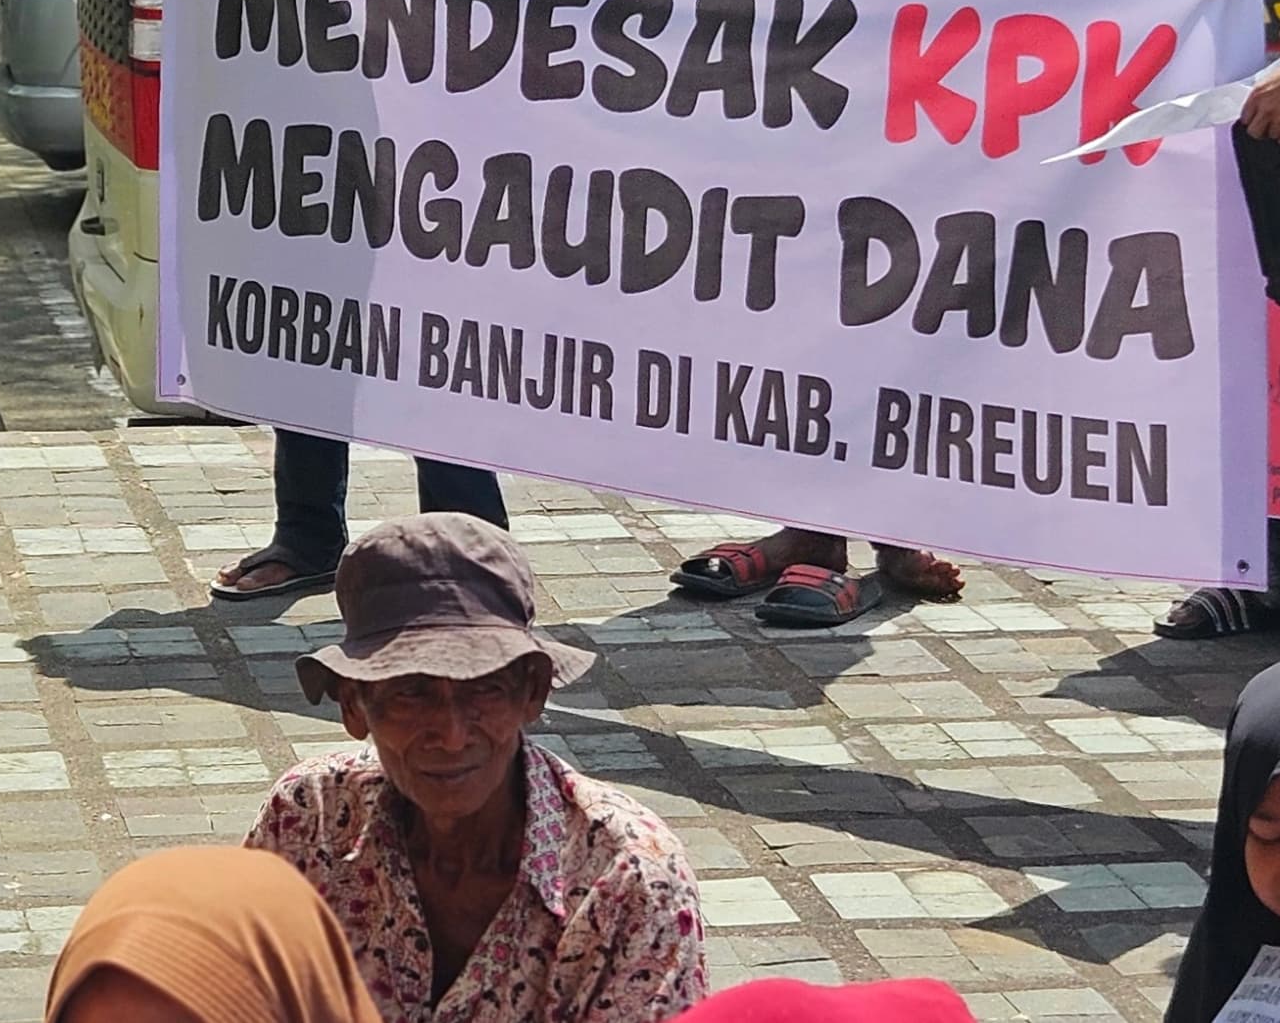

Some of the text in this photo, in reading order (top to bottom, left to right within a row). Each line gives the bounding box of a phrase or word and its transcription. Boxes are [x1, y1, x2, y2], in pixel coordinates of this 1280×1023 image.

[885, 4, 1177, 166] KPK
[197, 114, 1194, 360] MENGAUDIT DANA
[208, 275, 1167, 506] KORBAN BANJIR DI KAB. BIREUEN
